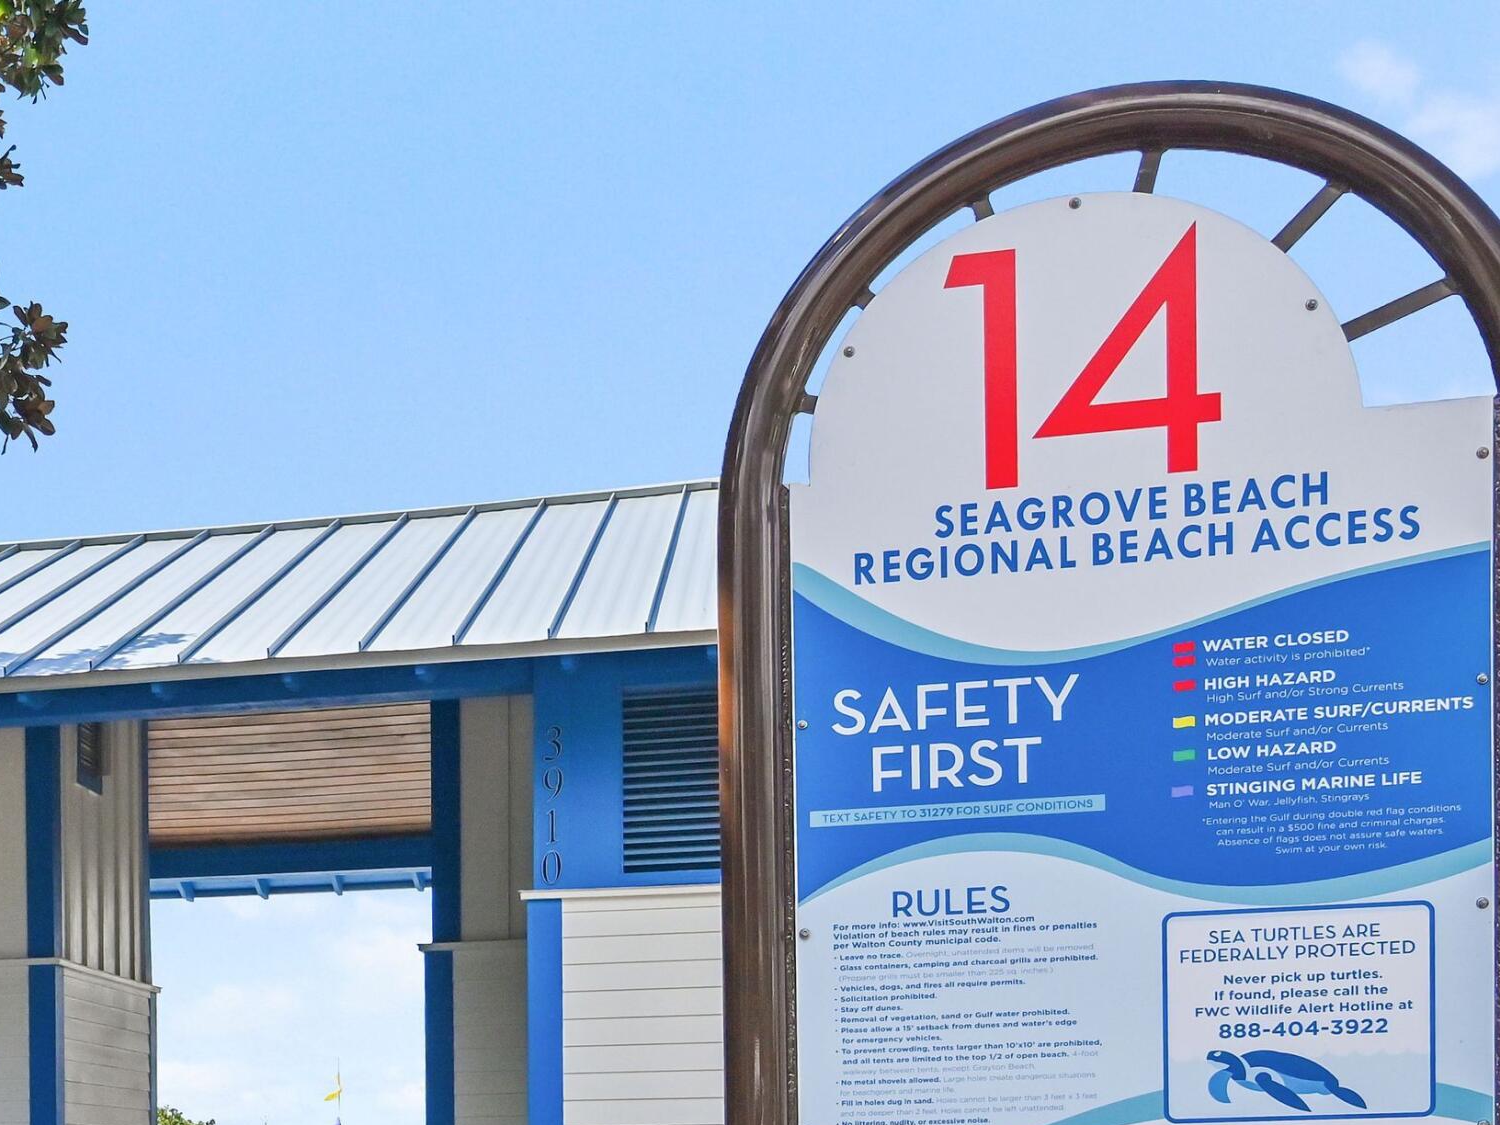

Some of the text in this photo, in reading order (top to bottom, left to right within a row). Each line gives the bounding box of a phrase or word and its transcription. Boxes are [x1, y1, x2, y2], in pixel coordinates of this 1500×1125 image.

[941, 220, 1223, 490] 14
[934, 471, 1328, 539] SEAGROVE BEACH
[854, 504, 1420, 585] REGIONAL BEACH ACCESS
[1202, 629, 1349, 652] WATER CLOSED
[1205, 656, 1241, 667] Water
[1243, 653, 1288, 664] activity
[1204, 669, 1336, 690] HIGH HAZARD
[1206, 681, 1404, 704] High Surf and/or Strong Currents
[831, 673, 1079, 736] SAFETY
[1204, 696, 1474, 726] MODERATE SURF/CURRENTS
[1206, 721, 1389, 741] Moderate Surf and/or Currents
[1207, 740, 1336, 760] LOW HAZARD
[872, 736, 1042, 792] FIRST
[1207, 756, 1390, 775] Moderate Surf and/or Currents
[1206, 771, 1422, 796] STINGING MARINE LIFE
[541, 725, 564, 885] 3910
[822, 812, 850, 823] TEXT
[853, 810, 897, 822] SAFETY
[900, 808, 917, 819] TO
[955, 804, 981, 816] FOR
[982, 802, 1013, 815] SURF
[1015, 798, 1093, 813] CONDITIONS
[1327, 808, 1363, 819] double
[1407, 803, 1462, 814] conditions
[892, 885, 1010, 918] RULES
[1051, 921, 1097, 932] penalties
[1208, 922, 1380, 944] SEA TURTLES ARE
[1179, 939, 1415, 963] FEDERALLY PROTECTED
[1223, 968, 1383, 985] Never pick up turtles.
[1214, 984, 1388, 1001] If found, please call the
[1194, 999, 1413, 1018] FWC Wildlife Alert Hotline at
[1218, 1017, 1388, 1039] 888-404-3922
